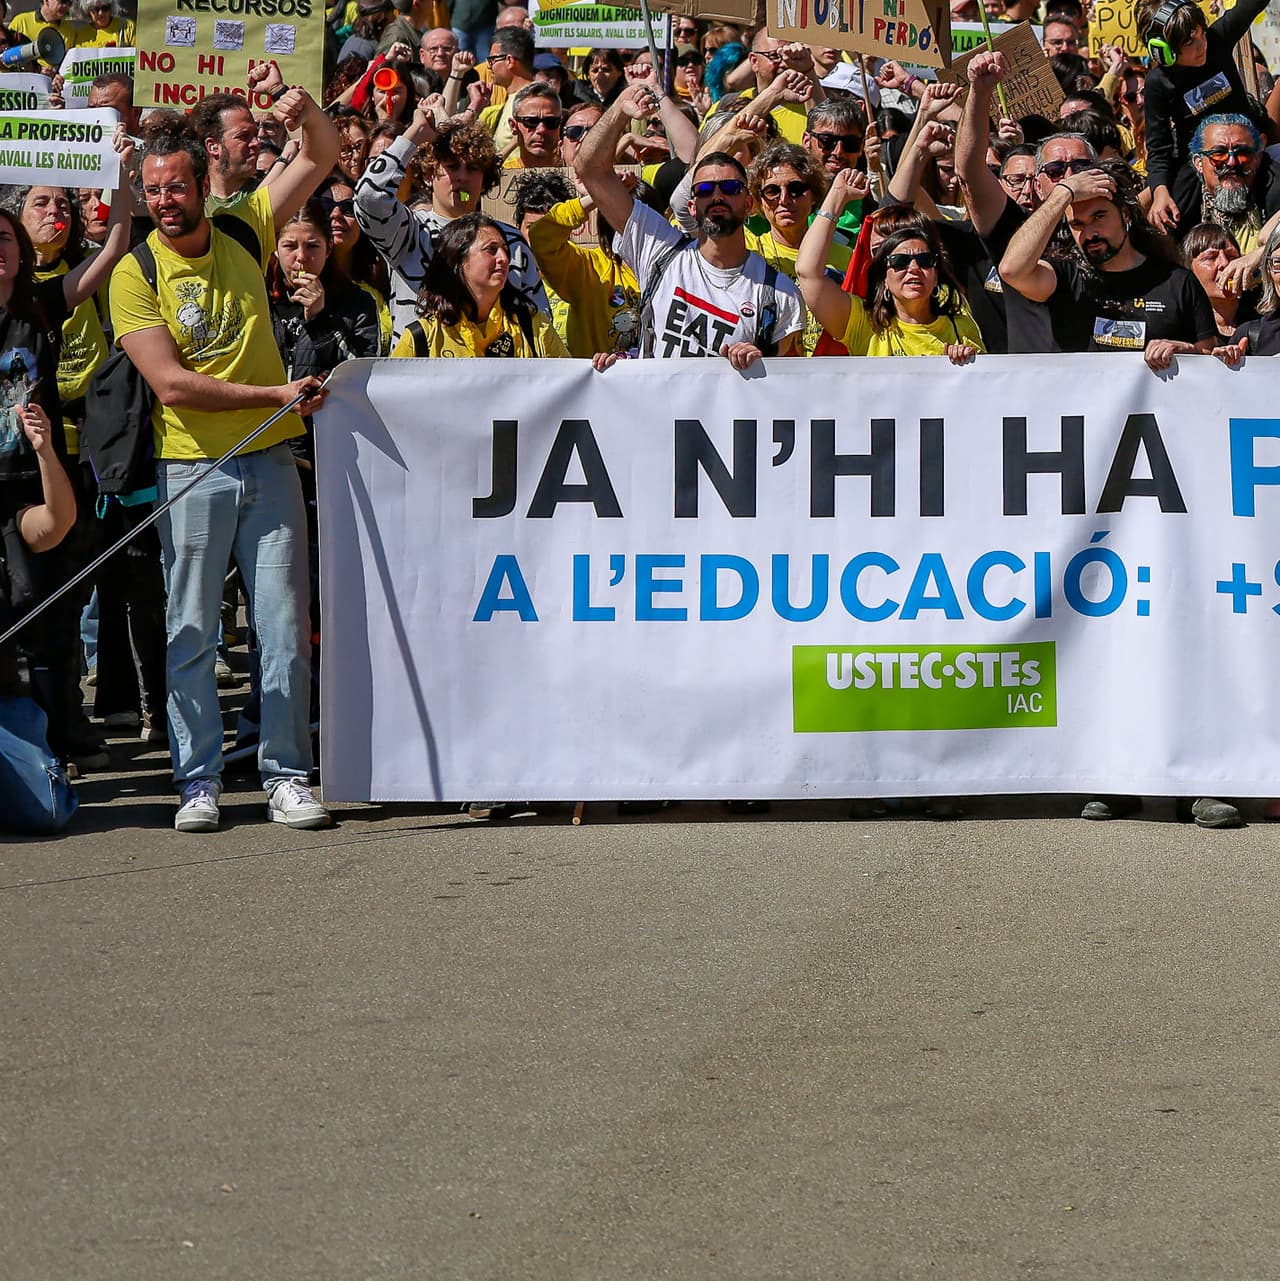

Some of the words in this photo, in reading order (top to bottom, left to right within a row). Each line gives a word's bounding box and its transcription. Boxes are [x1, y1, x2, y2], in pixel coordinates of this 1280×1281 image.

[602, 8, 613, 22] LA
[540, 28, 562, 38] AMUNT
[565, 28, 575, 38] ELS
[606, 28, 624, 38] AVALL
[626, 28, 637, 38] LES
[139, 51, 175, 73] NO
[198, 54, 224, 76] HI
[18, 120, 102, 143] PROFESSIÓ
[36, 151, 54, 169] LES
[57, 149, 101, 170] RÀTIOS!
[665, 299, 736, 354] EAT
[473, 420, 623, 518] JA
[675, 418, 944, 518] N'HI
[1003, 414, 1187, 516] HA
[473, 555, 538, 622] A
[1007, 692, 1043, 714] IAC
